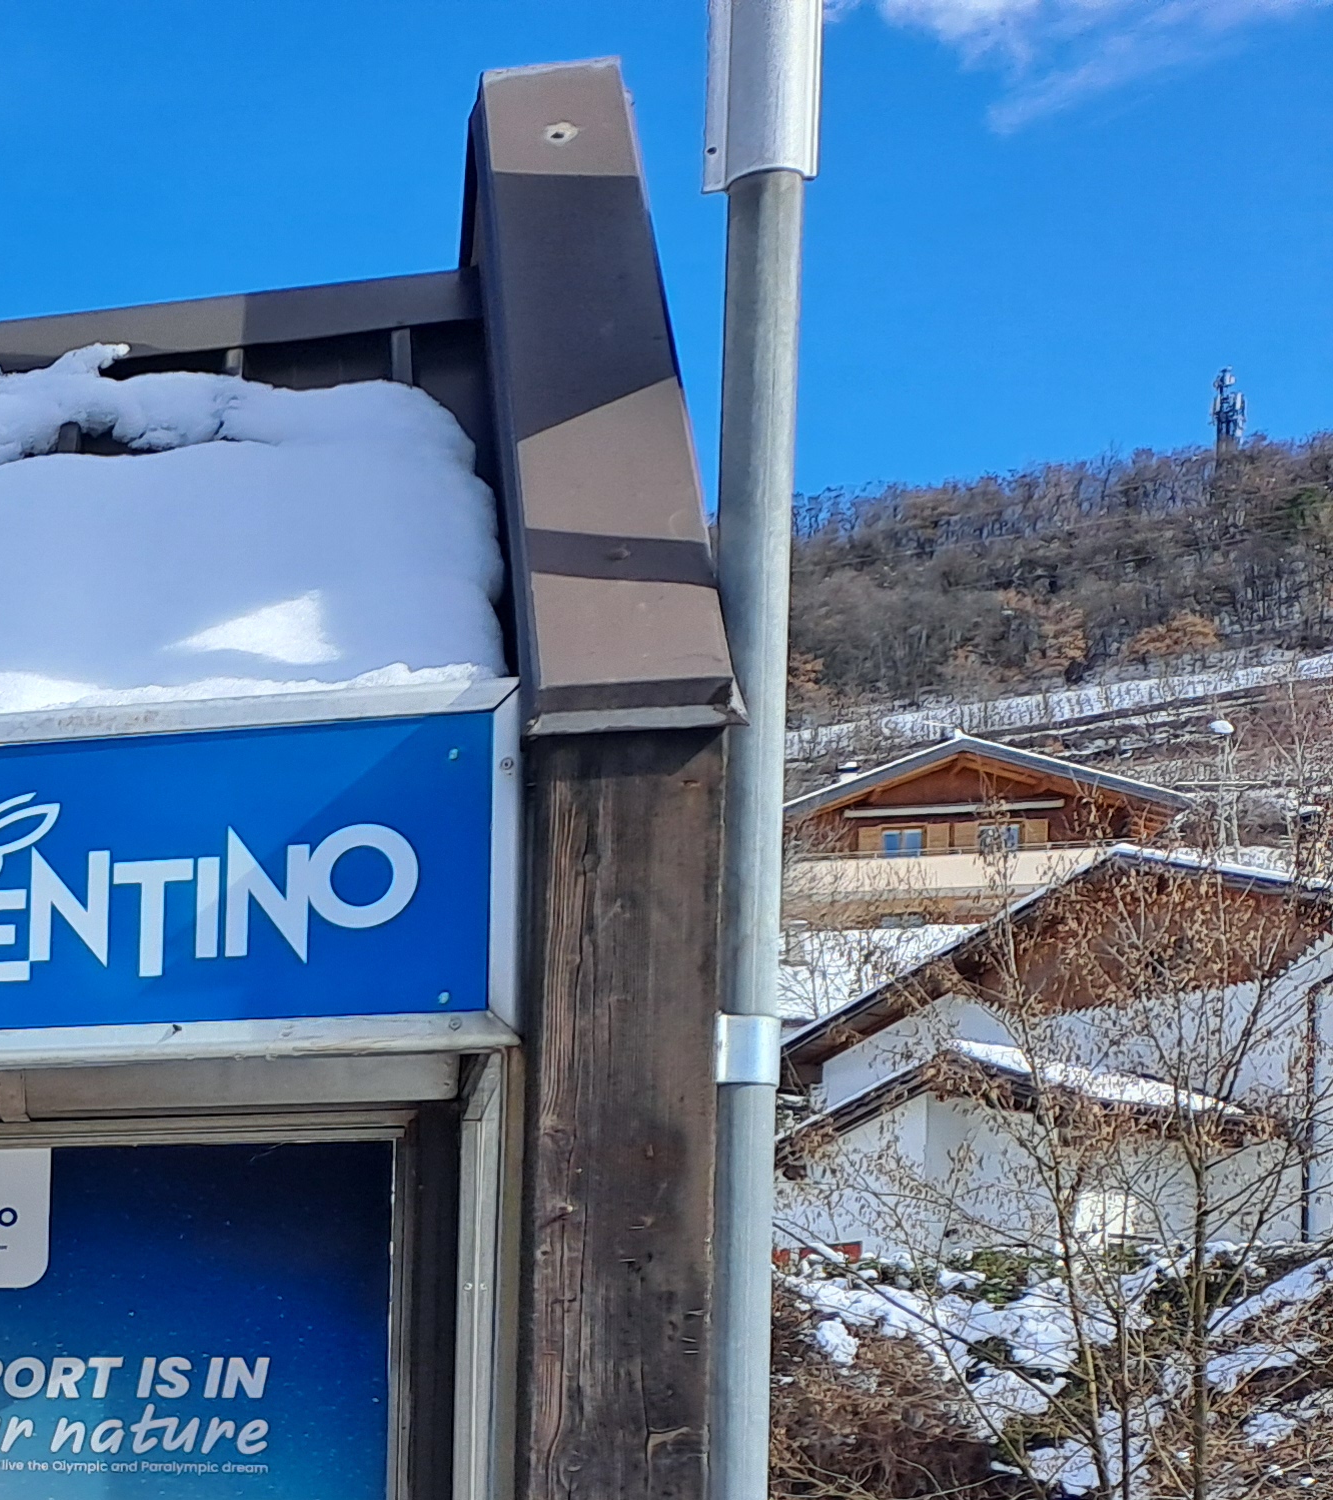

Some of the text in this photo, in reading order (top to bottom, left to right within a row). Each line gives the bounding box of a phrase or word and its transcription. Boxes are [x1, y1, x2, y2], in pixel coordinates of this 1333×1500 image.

[136, 1356, 192, 1399] IS
[202, 1356, 270, 1399] IN
[50, 1403, 270, 1455] nature
[2, 1459, 24, 1470] live
[28, 1459, 49, 1471] the
[53, 1459, 108, 1474] Olympic
[111, 1460, 138, 1472] and
[141, 1461, 219, 1476] Paralympic
[222, 1462, 269, 1473] dream
